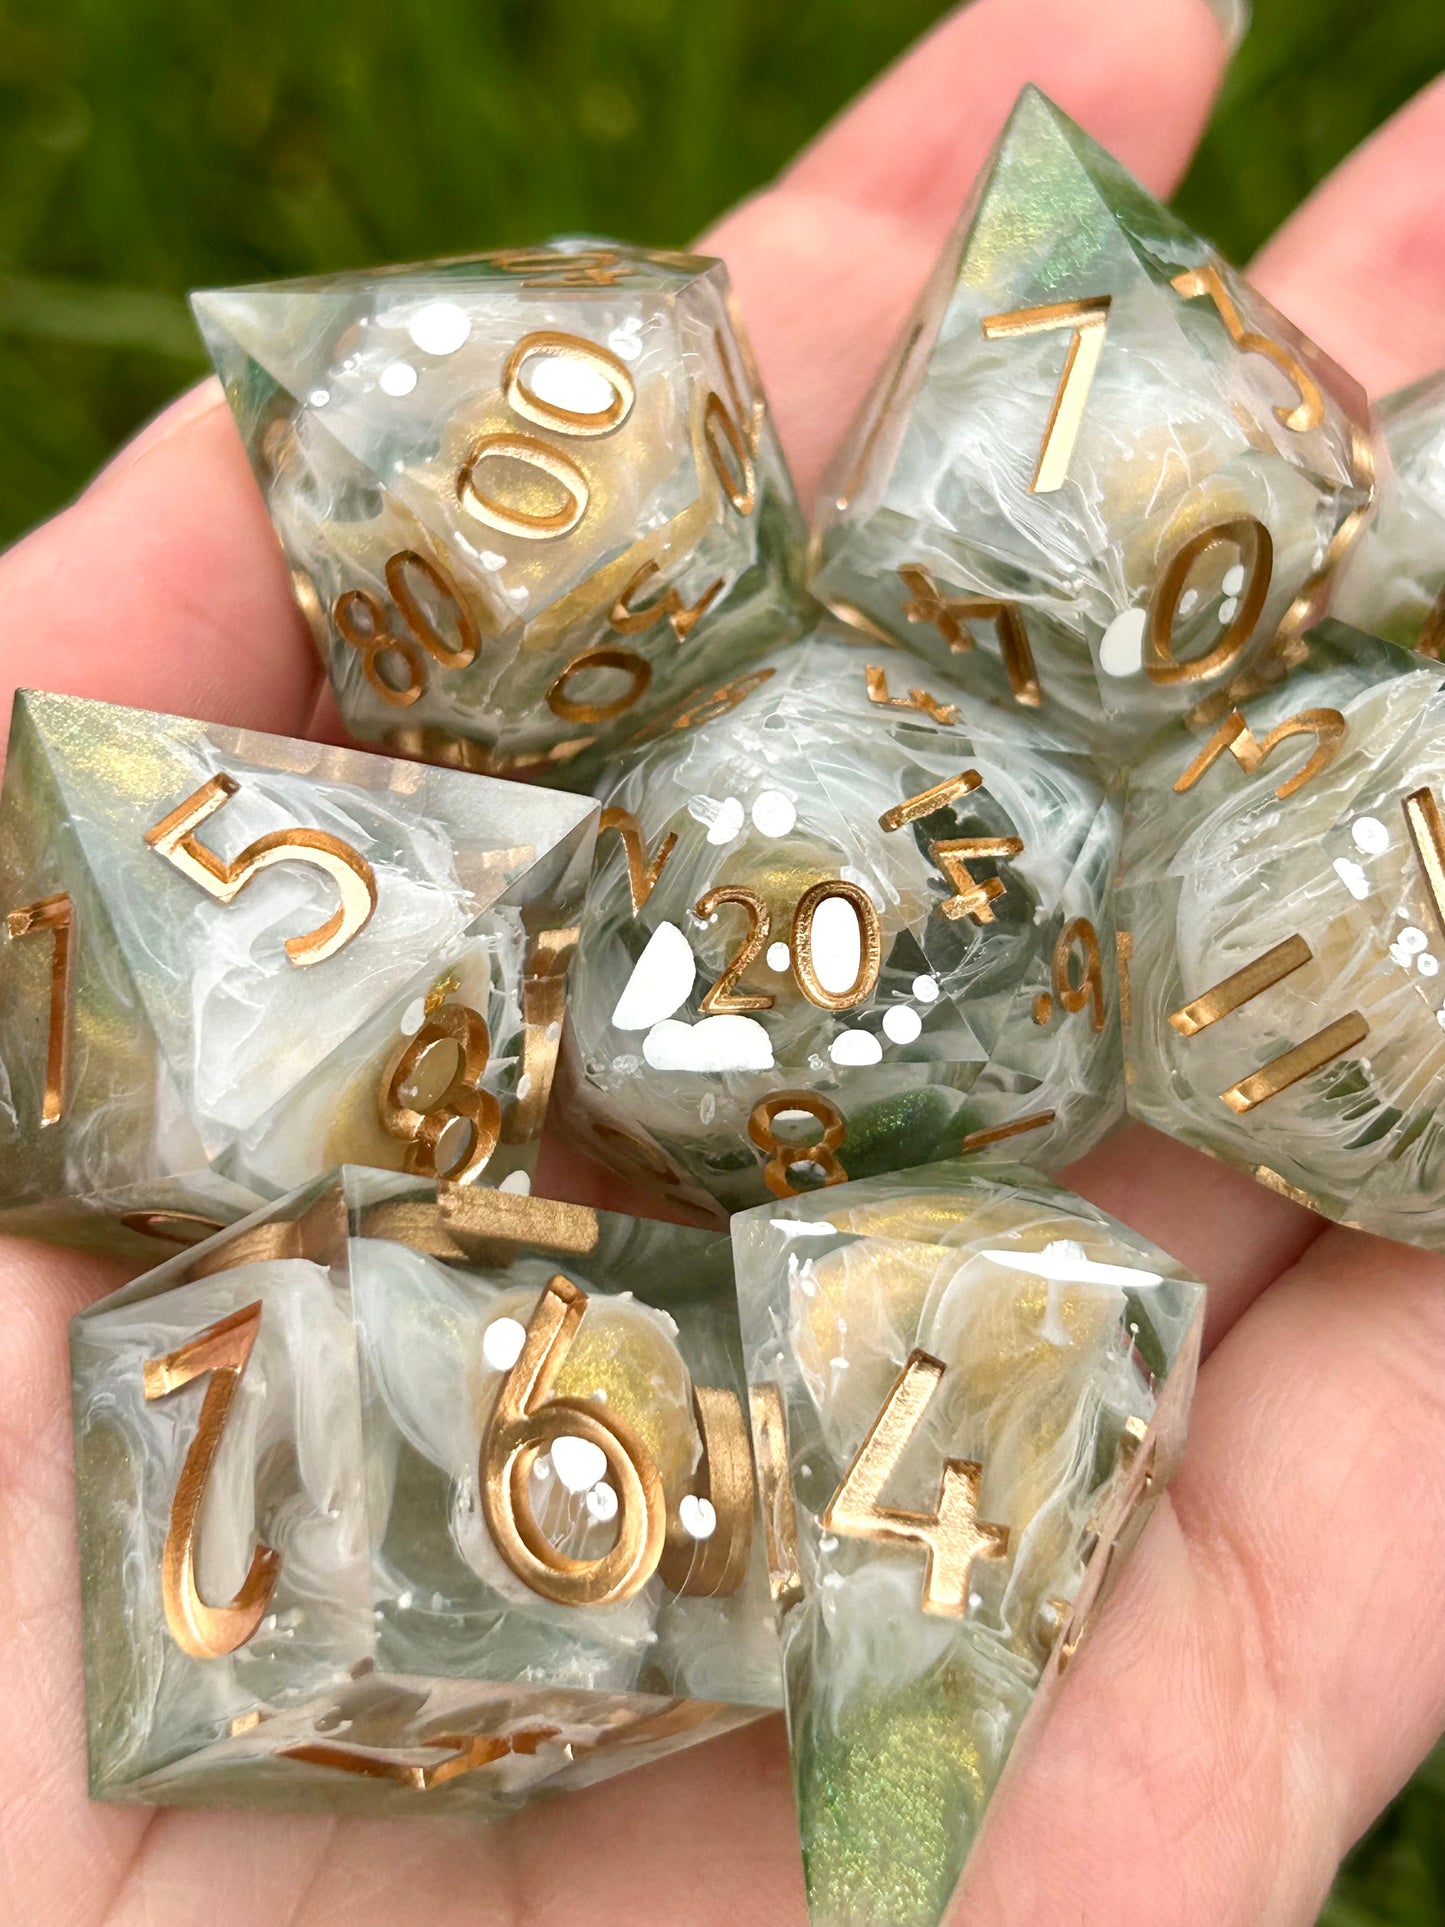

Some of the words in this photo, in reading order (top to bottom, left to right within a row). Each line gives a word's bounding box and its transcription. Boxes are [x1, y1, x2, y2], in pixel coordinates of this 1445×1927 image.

[982, 294, 1113, 494] 7
[332, 550, 482, 708] 80
[1144, 513, 1274, 686] 0
[144, 771, 379, 969] 5
[877, 768, 1024, 926] 14
[696, 879, 882, 1013] 20
[747, 1088, 848, 1199] 8
[479, 1273, 667, 1606] 6
[818, 1347, 1011, 1619] 4
